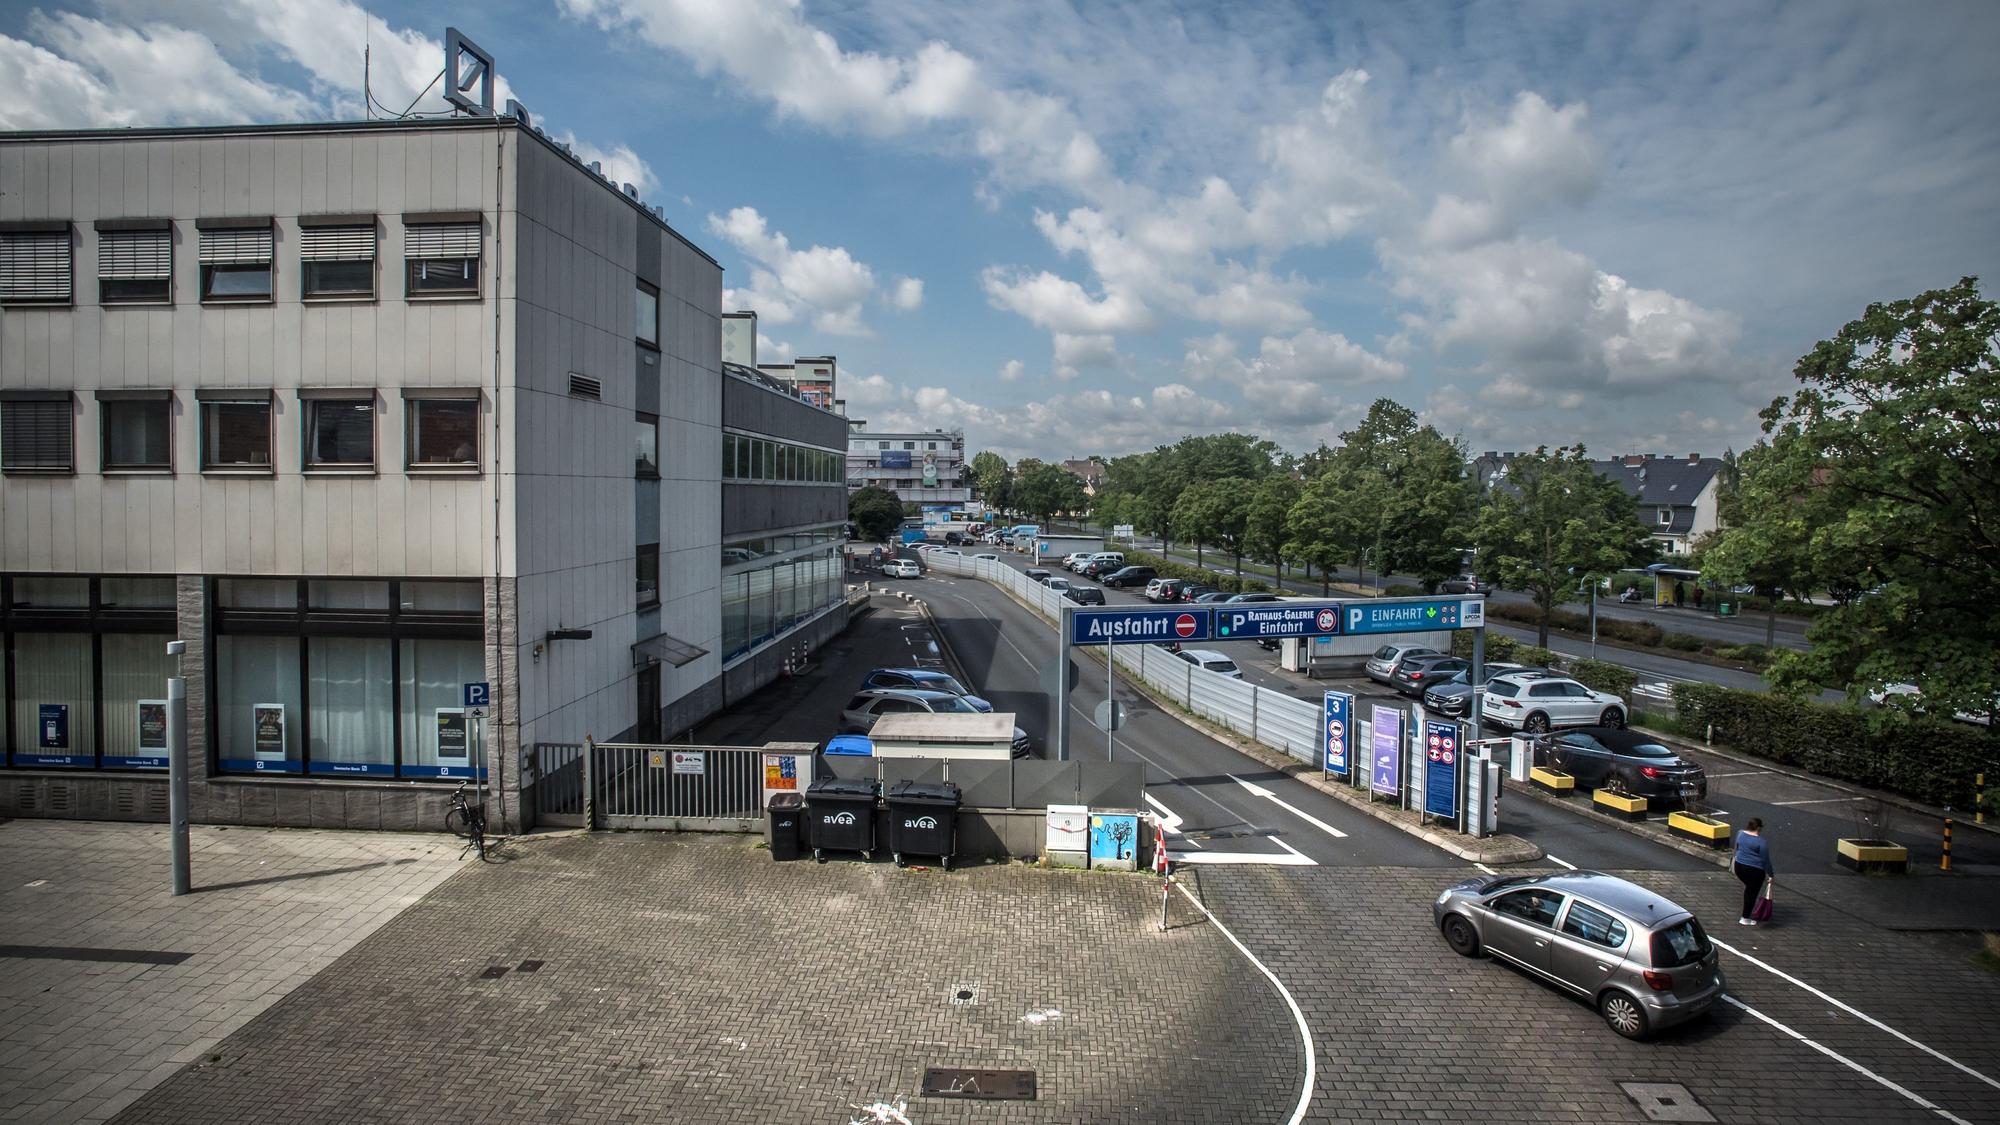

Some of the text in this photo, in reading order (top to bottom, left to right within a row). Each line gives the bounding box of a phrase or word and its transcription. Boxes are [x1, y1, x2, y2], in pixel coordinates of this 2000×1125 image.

[1350, 608, 1363, 630] P
[1372, 607, 1423, 621] EINFAHRT
[1088, 617, 1168, 636] Ausfahrt
[1232, 614, 1245, 631] P
[1260, 621, 1304, 634] Einfahrt
[469, 685, 484, 703] P
[1332, 700, 1340, 713] 3
[824, 812, 855, 825] avea
[905, 817, 937, 829] avea
